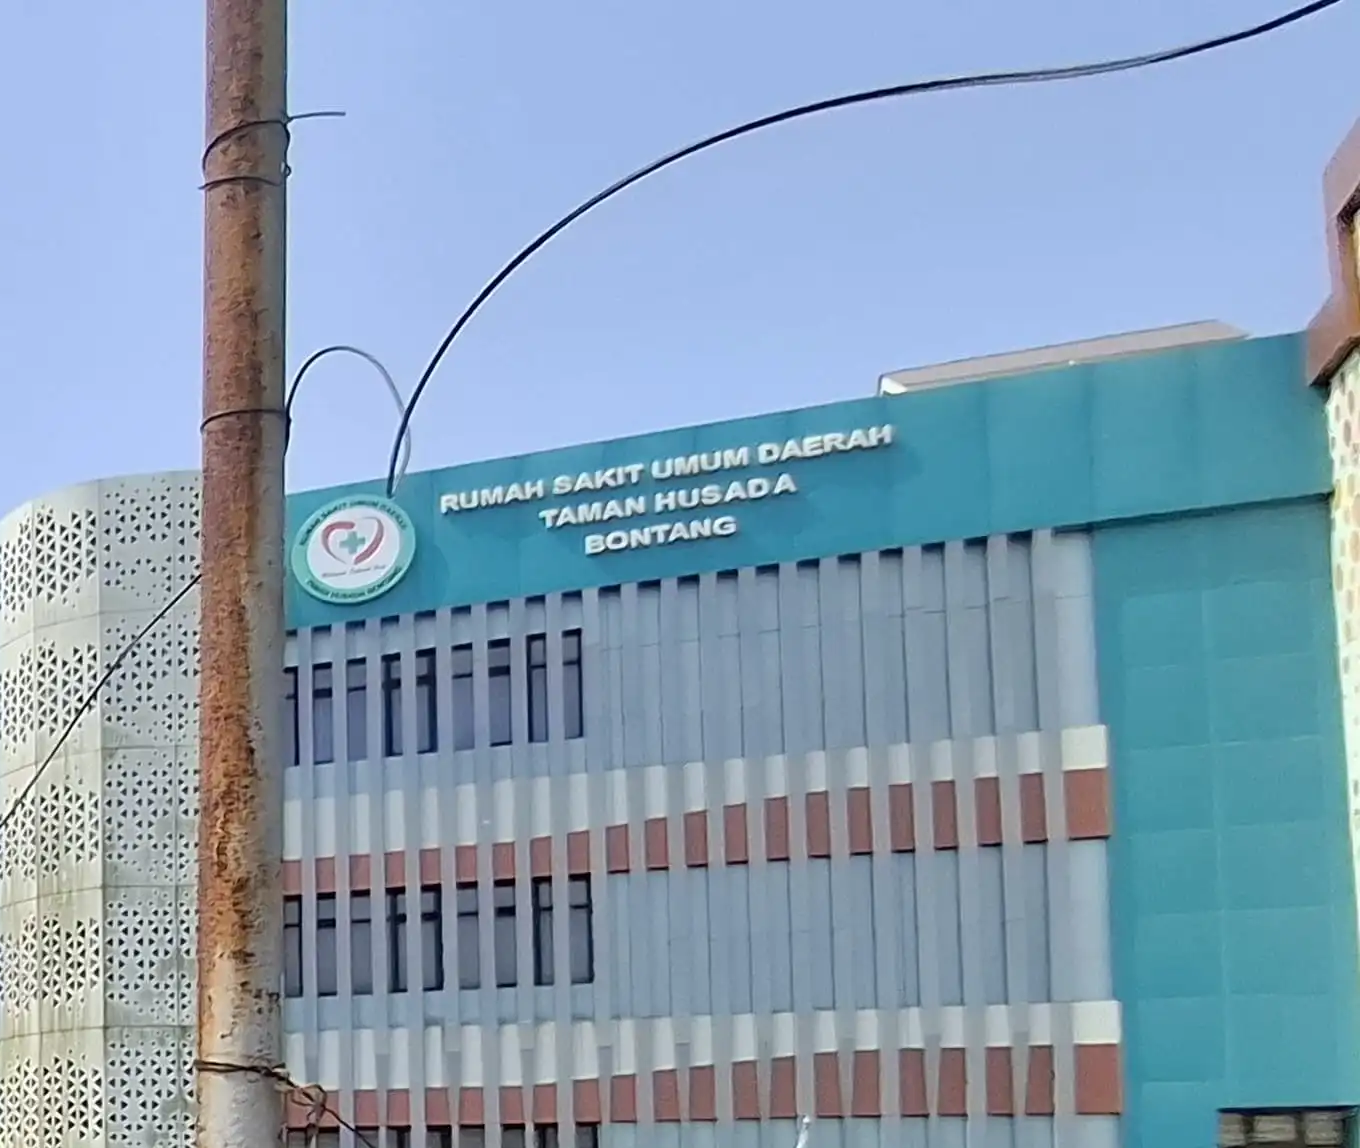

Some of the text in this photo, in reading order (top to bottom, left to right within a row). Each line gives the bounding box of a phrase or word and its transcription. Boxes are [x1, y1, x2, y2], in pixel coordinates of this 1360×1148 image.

[440, 424, 893, 514] RUMAH SAKIT UMUM DAERAH
[538, 473, 798, 530] TAMAN HUSADA
[584, 516, 737, 556] BONTANG
